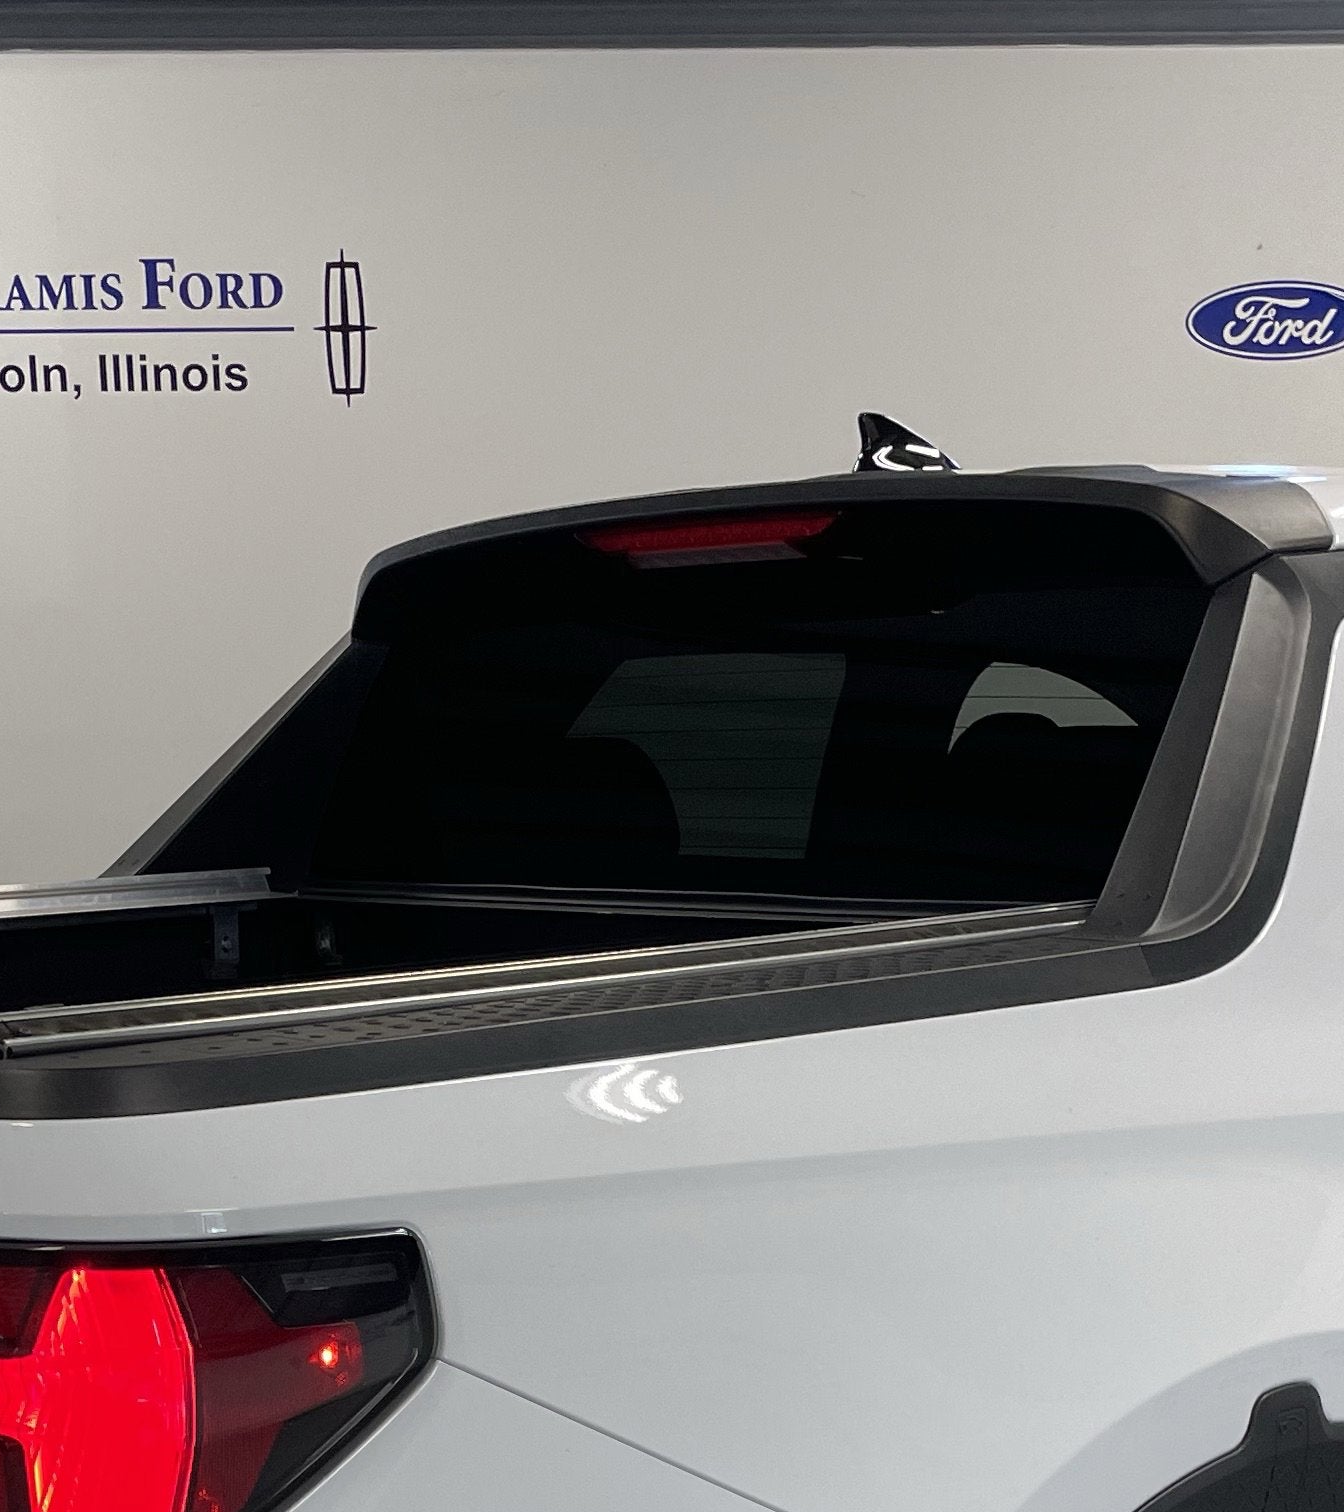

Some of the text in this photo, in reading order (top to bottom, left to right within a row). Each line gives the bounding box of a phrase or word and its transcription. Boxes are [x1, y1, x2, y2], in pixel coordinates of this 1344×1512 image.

[138, 257, 284, 311] FORD
[1222, 296, 1335, 347] Ford
[97, 352, 249, 393] Illinois
